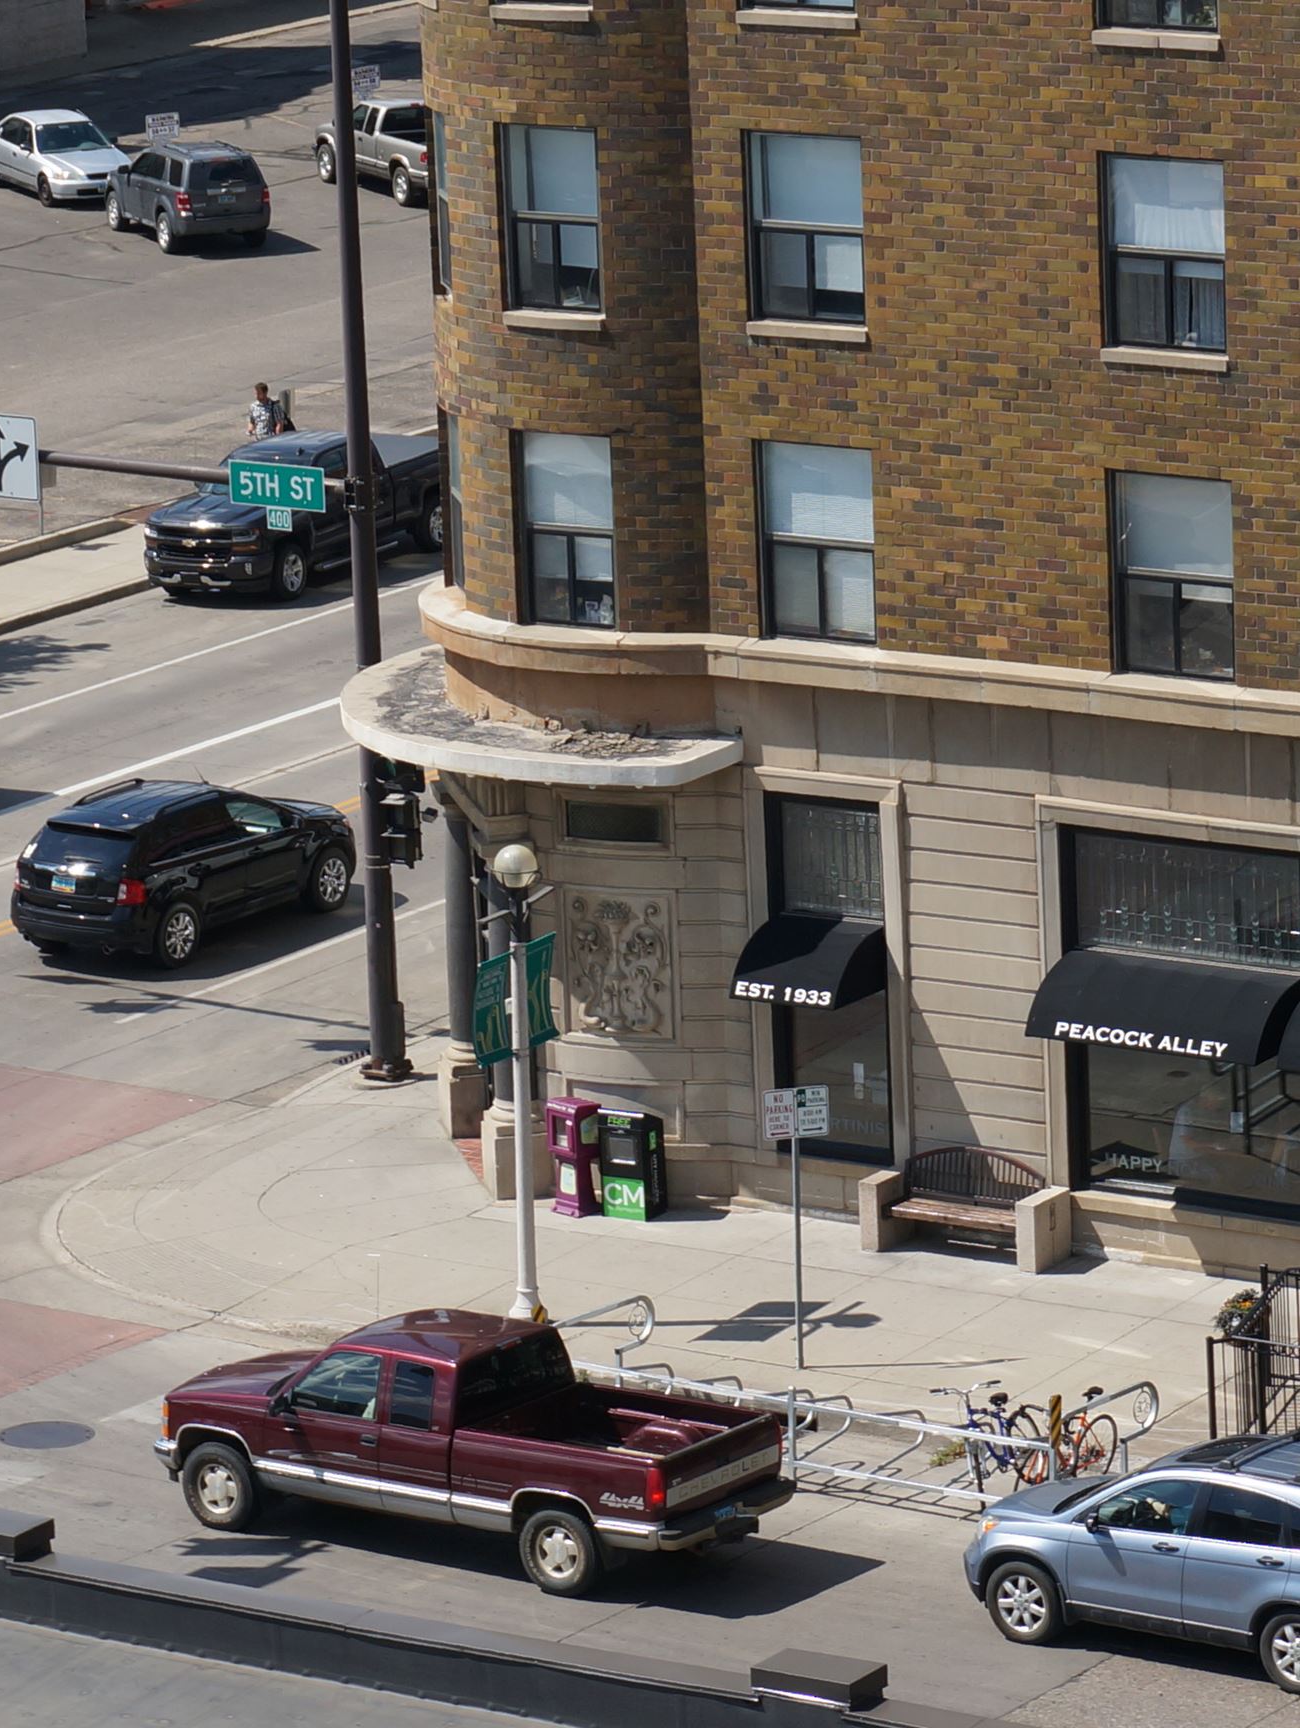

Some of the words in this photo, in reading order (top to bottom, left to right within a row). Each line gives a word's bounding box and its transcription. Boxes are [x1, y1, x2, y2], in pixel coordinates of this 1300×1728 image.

[239, 471, 280, 498] 5TH
[290, 475, 315, 501] ST
[269, 510, 289, 528] 400
[734, 980, 775, 1000] EST.
[784, 986, 832, 1006] 1933
[1054, 1021, 1154, 1048] PEACOCK
[1157, 1035, 1228, 1057] ALLEY
[765, 1104, 793, 1114] PARKING
[773, 1094, 784, 1104] NO
[1105, 1152, 1164, 1173] HAPPY
[604, 1183, 645, 1208] CM
[678, 1452, 772, 1498] CHEVROLET
